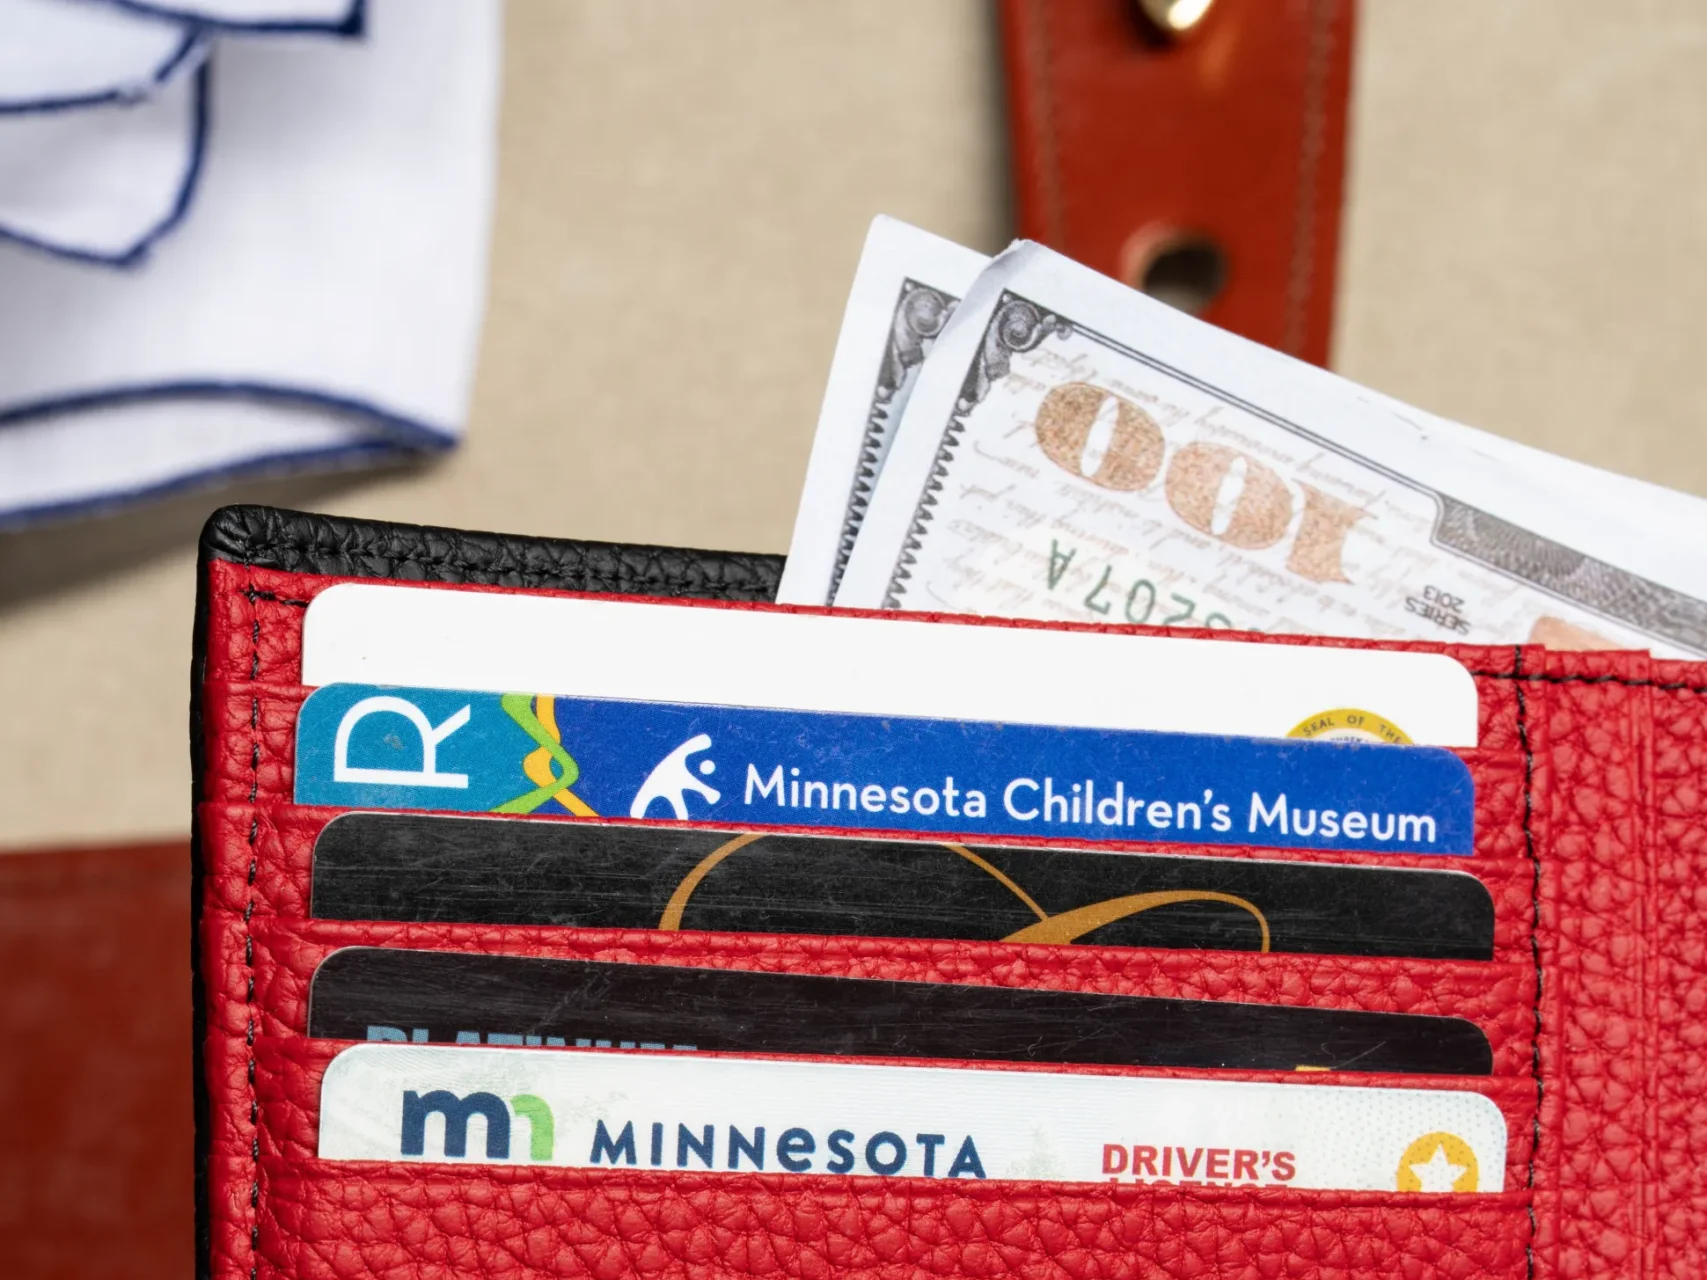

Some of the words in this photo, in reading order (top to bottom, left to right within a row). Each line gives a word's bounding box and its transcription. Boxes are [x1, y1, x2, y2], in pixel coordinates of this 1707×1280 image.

[1034, 382, 1379, 586] 100
[1404, 596, 1472, 635] SERIES
[1423, 584, 1465, 613] 2013
[333, 695, 471, 789] R
[1302, 716, 1335, 737] SEAL
[1345, 713, 1366, 726] OF
[744, 763, 986, 818] Minnesota
[1003, 777, 1232, 832] Children's
[1248, 792, 1437, 843] Museum
[1102, 1143, 1295, 1181] DRIVER'S
